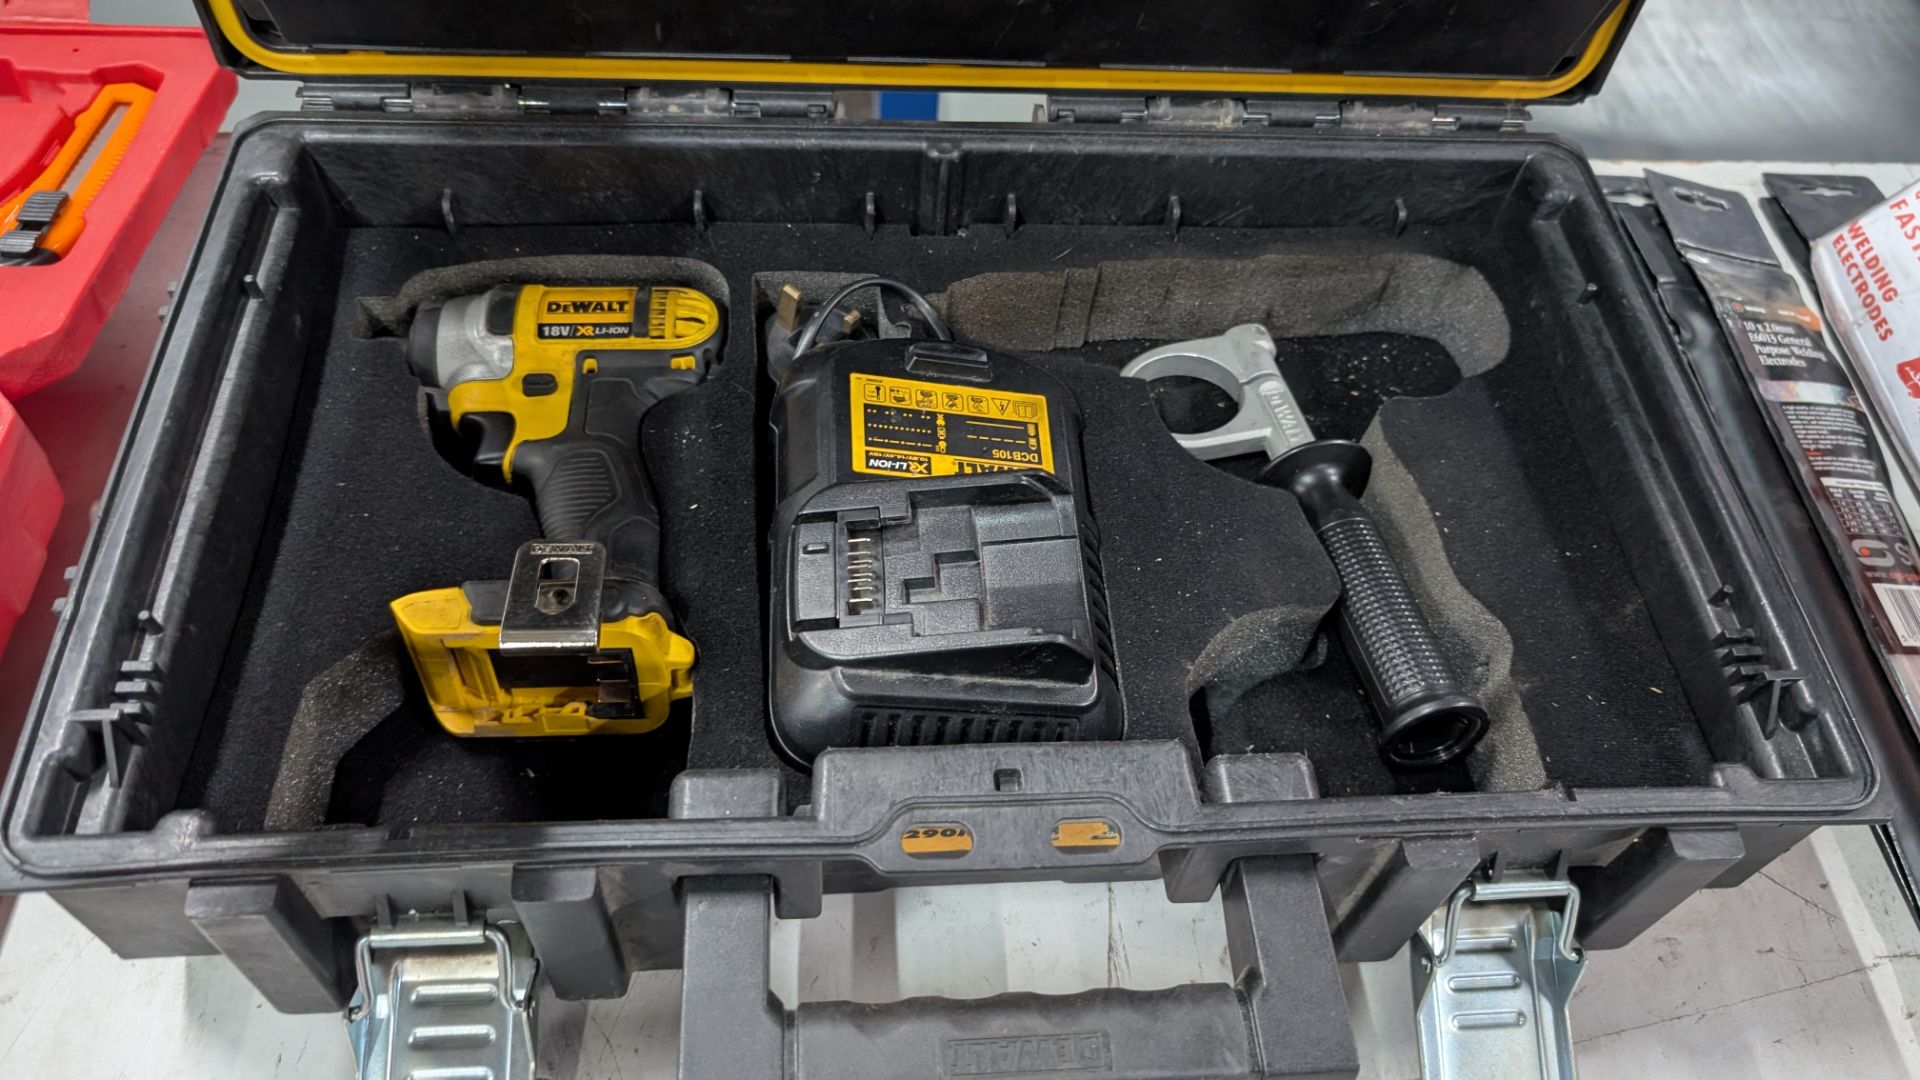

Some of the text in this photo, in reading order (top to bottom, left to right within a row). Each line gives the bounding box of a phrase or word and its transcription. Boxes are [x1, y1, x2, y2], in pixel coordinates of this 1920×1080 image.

[1847, 223, 1898, 302] WELDING
[1832, 233, 1893, 342] ELECTRODES
[595, 326, 629, 335] LI-ION
[1777, 334, 1813, 348] General
[1752, 343, 1828, 363] Purpose Welding
[1758, 355, 1808, 368] Electrodes
[992, 449, 1039, 463] DCB105
[869, 459, 907, 470] LI-ION
